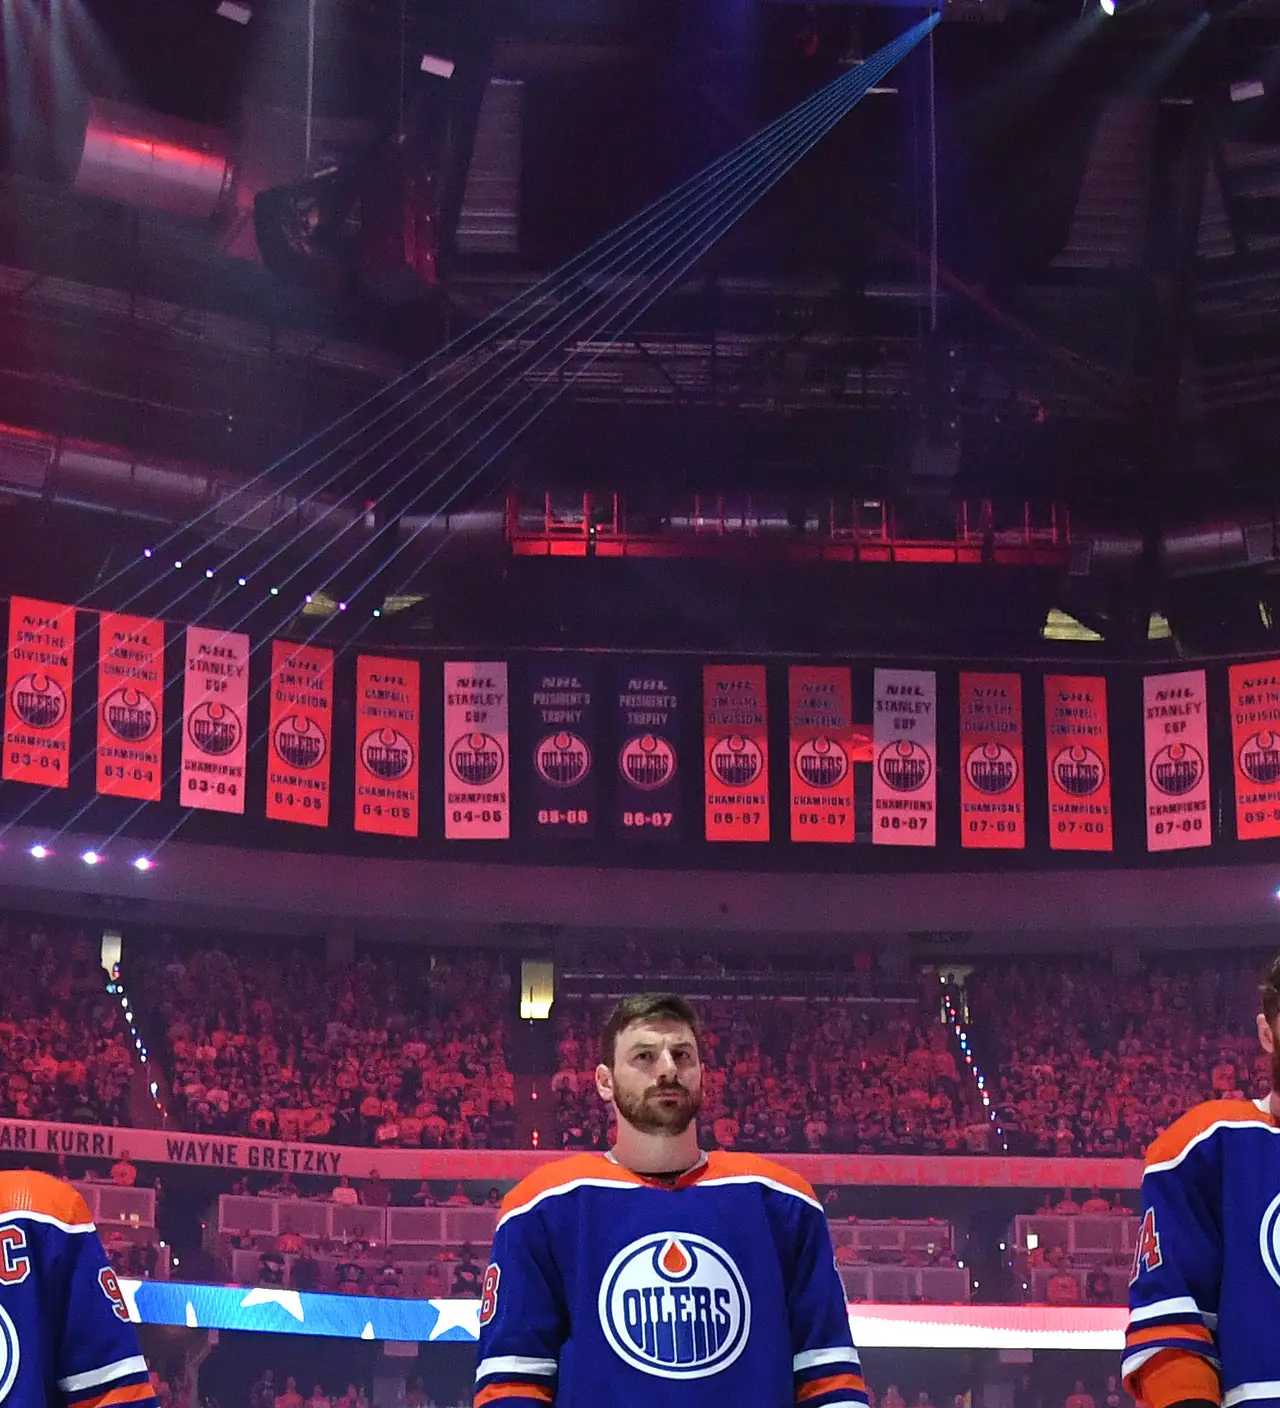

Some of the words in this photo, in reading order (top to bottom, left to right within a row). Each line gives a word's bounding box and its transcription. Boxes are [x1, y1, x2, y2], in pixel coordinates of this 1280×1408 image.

[189, 657, 245, 680] STANLEY
[16, 690, 60, 715] OILERS
[448, 692, 504, 707] STANLEY
[877, 699, 932, 716] STANLEY
[108, 704, 151, 728] OILERS
[1148, 700, 1203, 721] STANLEY
[193, 717, 235, 742] OILERS
[278, 731, 320, 755] OILERS
[366, 744, 407, 767] OILERS
[455, 751, 497, 769] OILERS
[541, 751, 584, 769] OILERS
[628, 754, 668, 771] OILERS
[715, 753, 757, 771] OILERS
[800, 755, 842, 773] OILERS
[883, 757, 924, 777] OILERS
[971, 761, 1012, 779] OILERS
[1058, 763, 1099, 782] OILERS
[1156, 759, 1198, 782] OILERS
[47, 1129, 114, 1154] KURRI
[167, 1138, 238, 1166] WAYNE
[249, 1146, 342, 1174] GRETZKY
